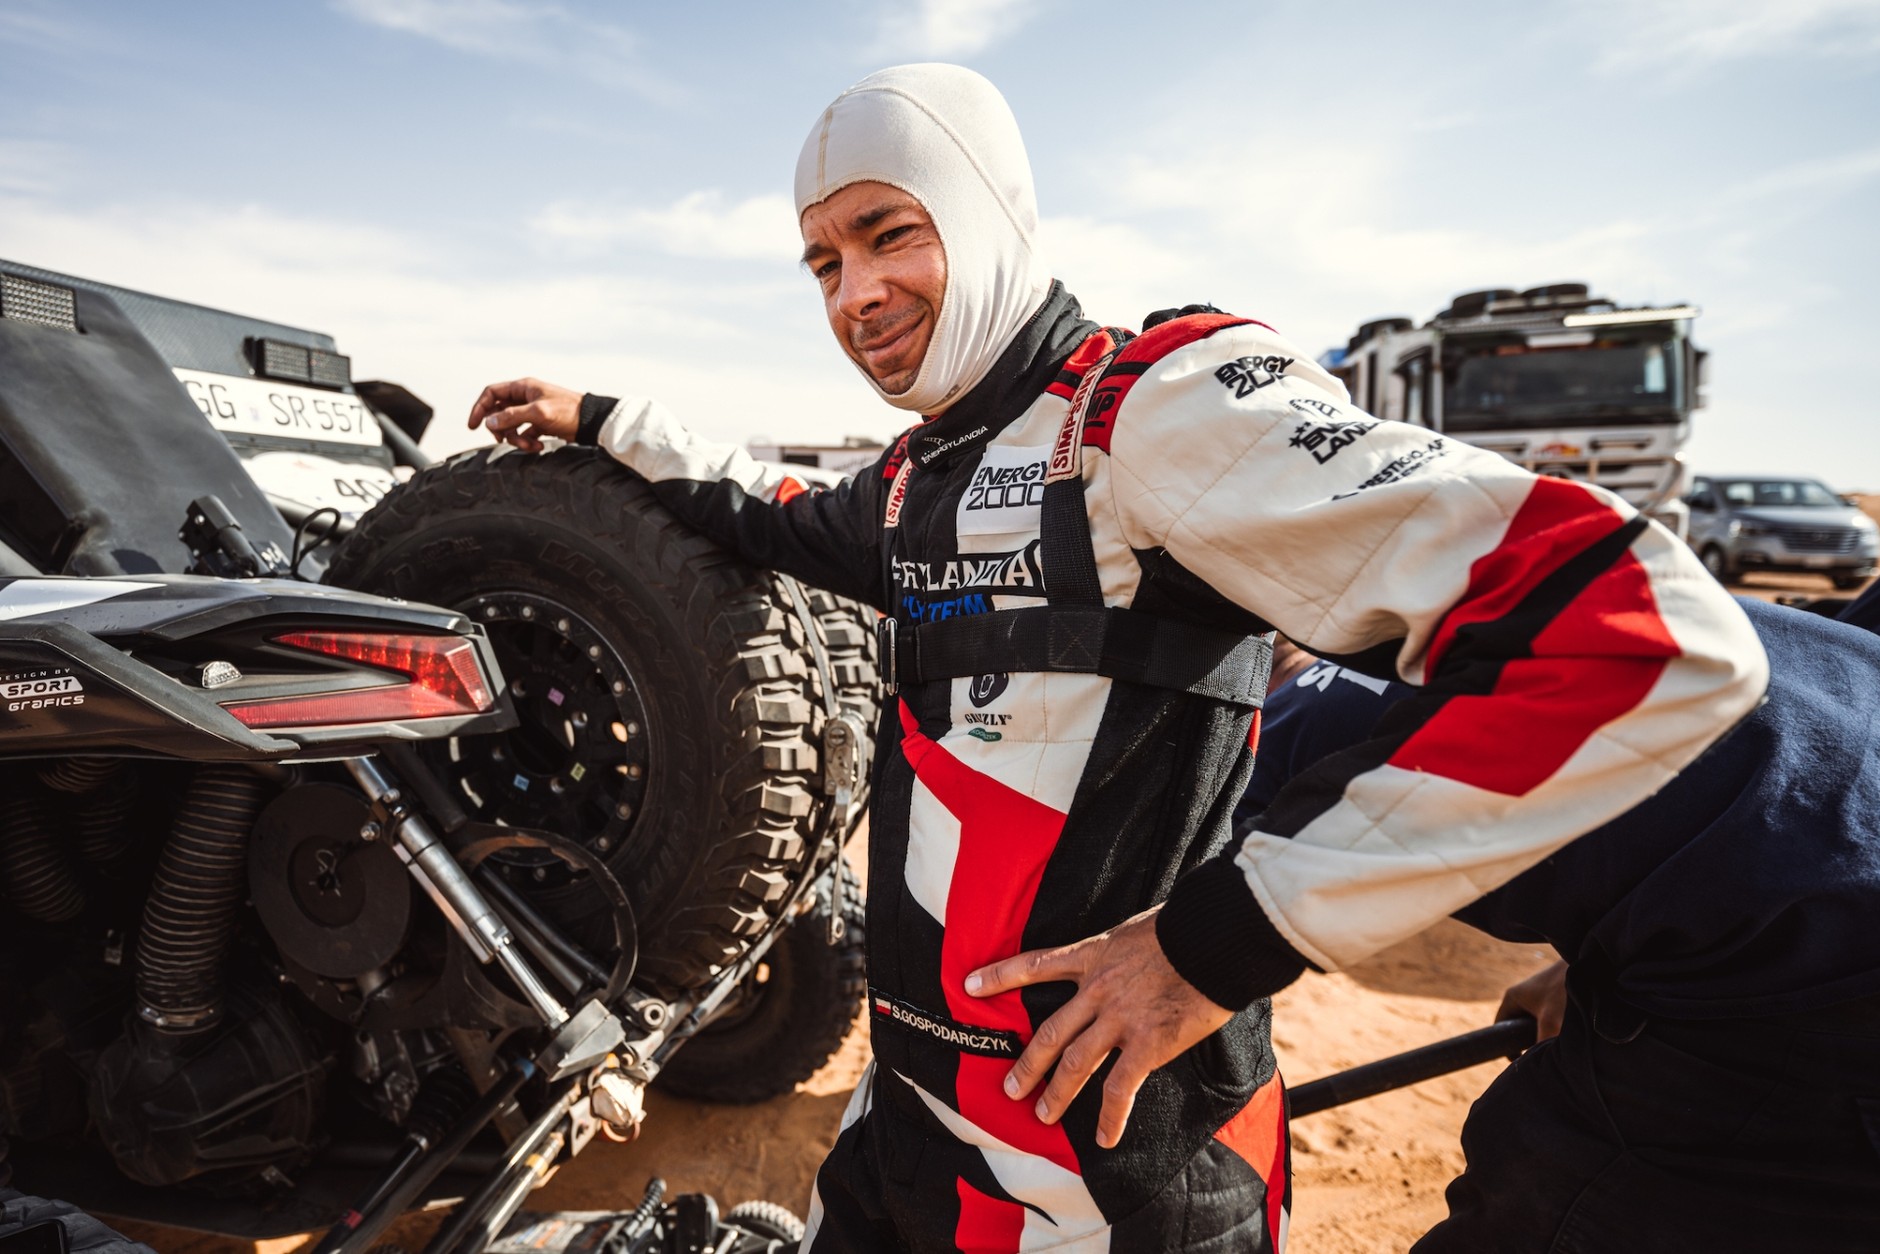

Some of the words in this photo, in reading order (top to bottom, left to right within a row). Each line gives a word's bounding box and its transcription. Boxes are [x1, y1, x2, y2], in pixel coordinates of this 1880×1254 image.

[268, 392, 311, 428] SR
[313, 399, 364, 434] 557
[921, 425, 989, 464] ENERGYLANDIA
[972, 460, 1047, 487] ENERGY
[966, 482, 1044, 511] 2000
[54, 667, 72, 676] BY
[7, 679, 73, 697] SPORT
[892, 1005, 1012, 1053] S.GOSPODARCZYK
